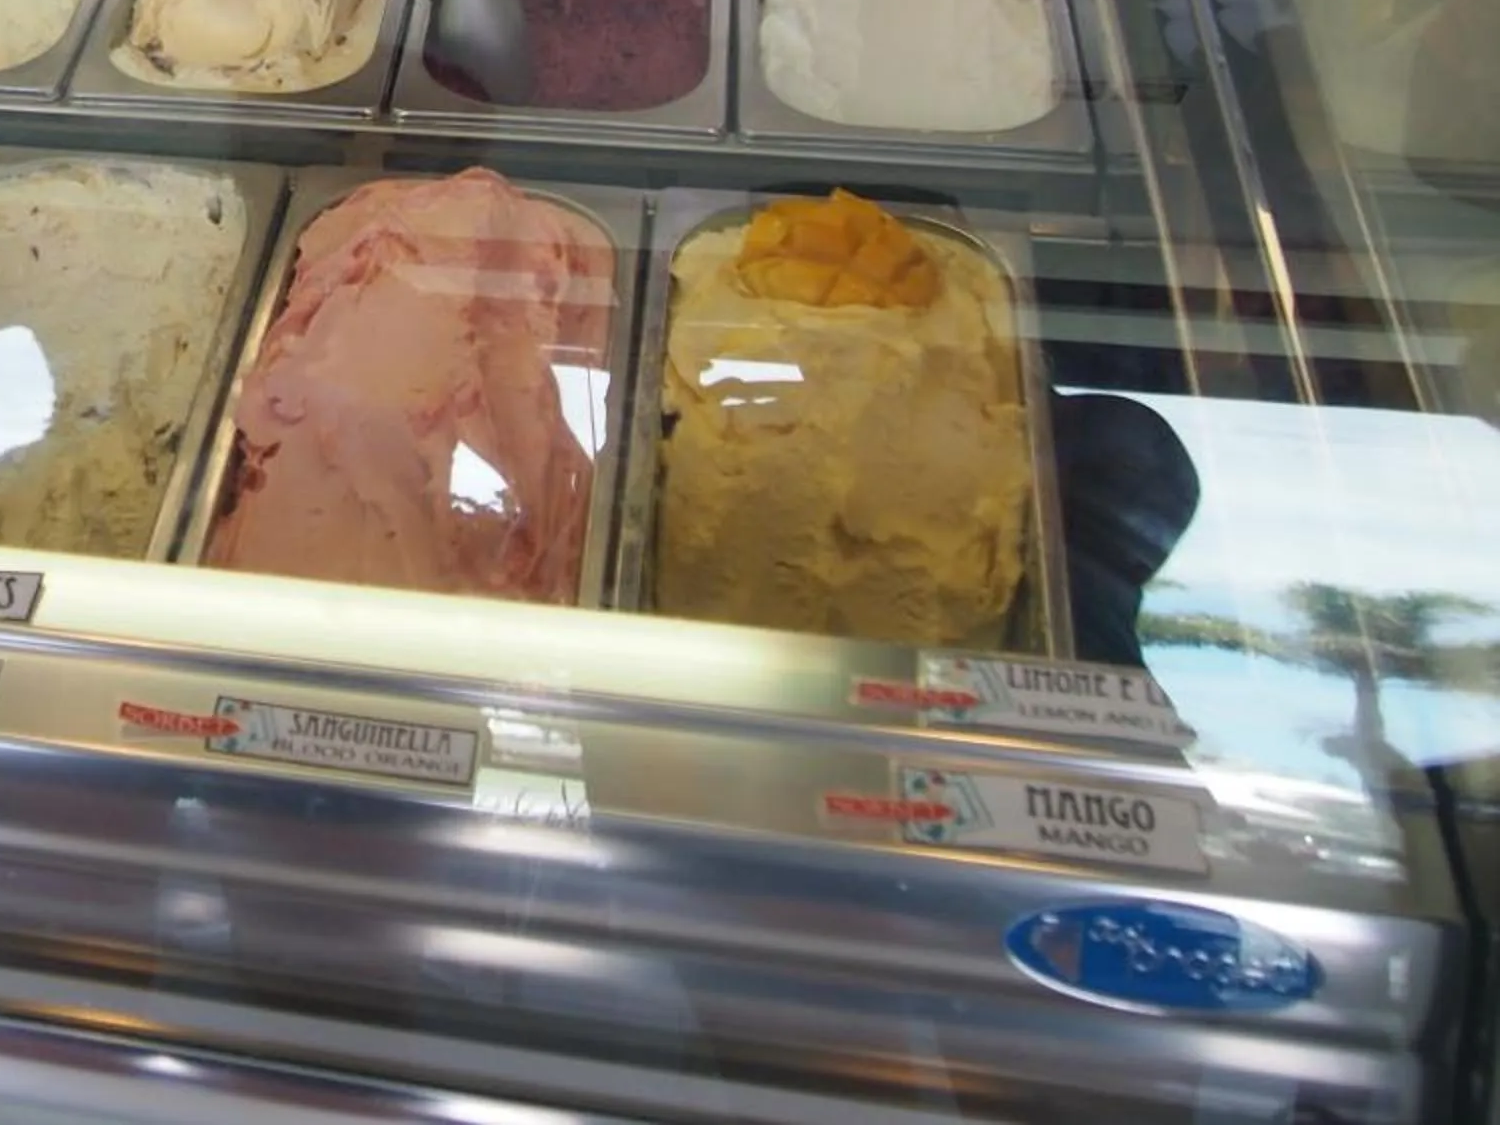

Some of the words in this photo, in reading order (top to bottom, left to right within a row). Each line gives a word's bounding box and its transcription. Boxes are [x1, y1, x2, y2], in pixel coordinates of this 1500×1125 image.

[1006, 663, 1107, 698] LIMONE
[289, 712, 451, 755] SANGUINELLA
[1024, 783, 1156, 833] MANGO
[1037, 824, 1150, 856] MANGO
